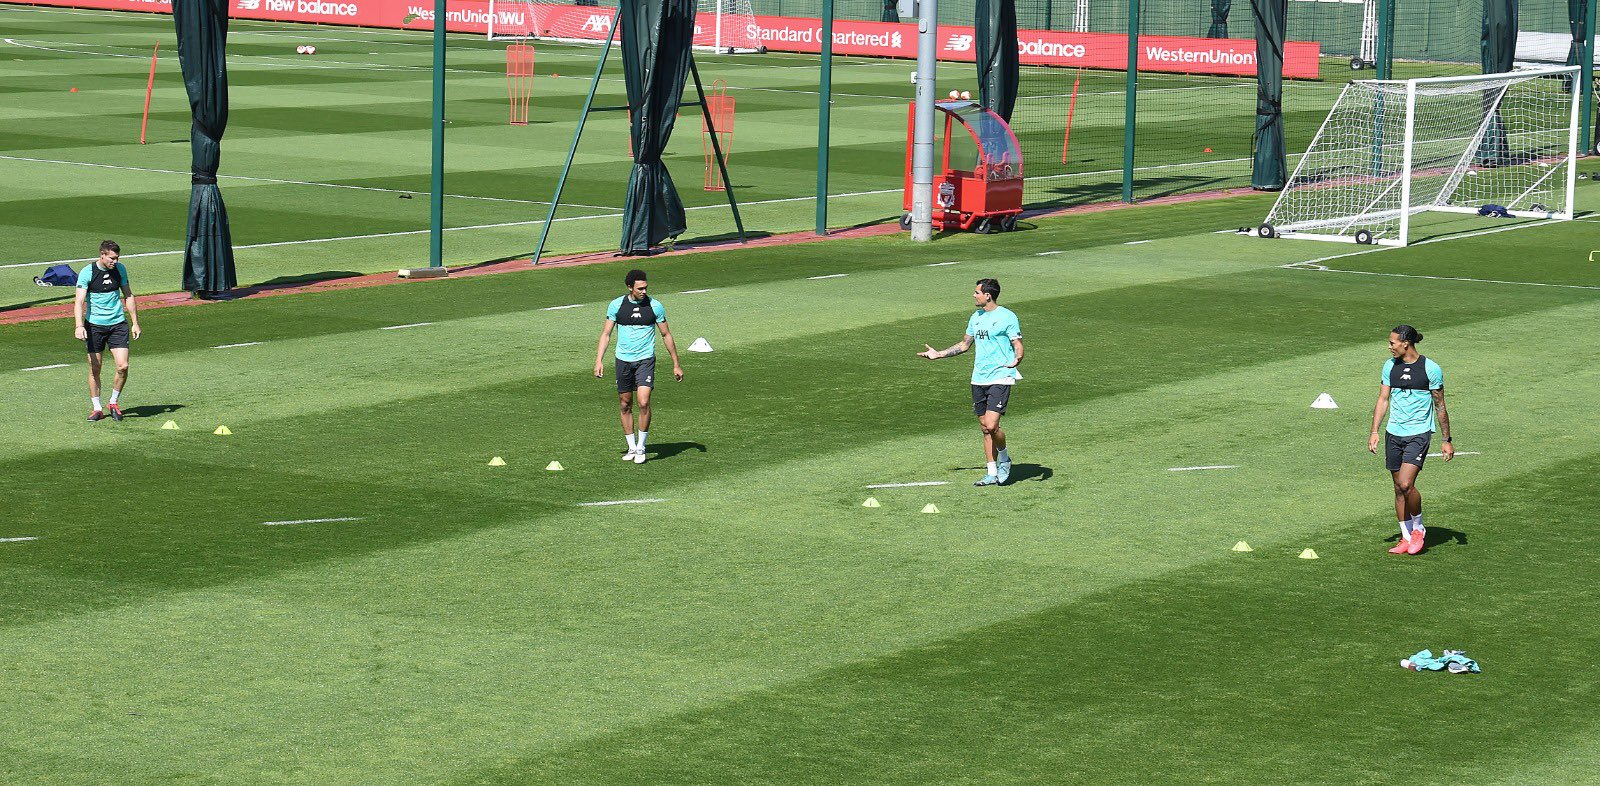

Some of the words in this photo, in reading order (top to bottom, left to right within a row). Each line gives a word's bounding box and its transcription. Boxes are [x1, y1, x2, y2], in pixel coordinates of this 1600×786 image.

[265, 0, 295, 12] new
[297, 0, 357, 16] balance
[581, 15, 611, 31] AXA
[746, 24, 812, 42] Standard
[1017, 38, 1085, 57] balance
[1146, 46, 1252, 65] WesternUnion
